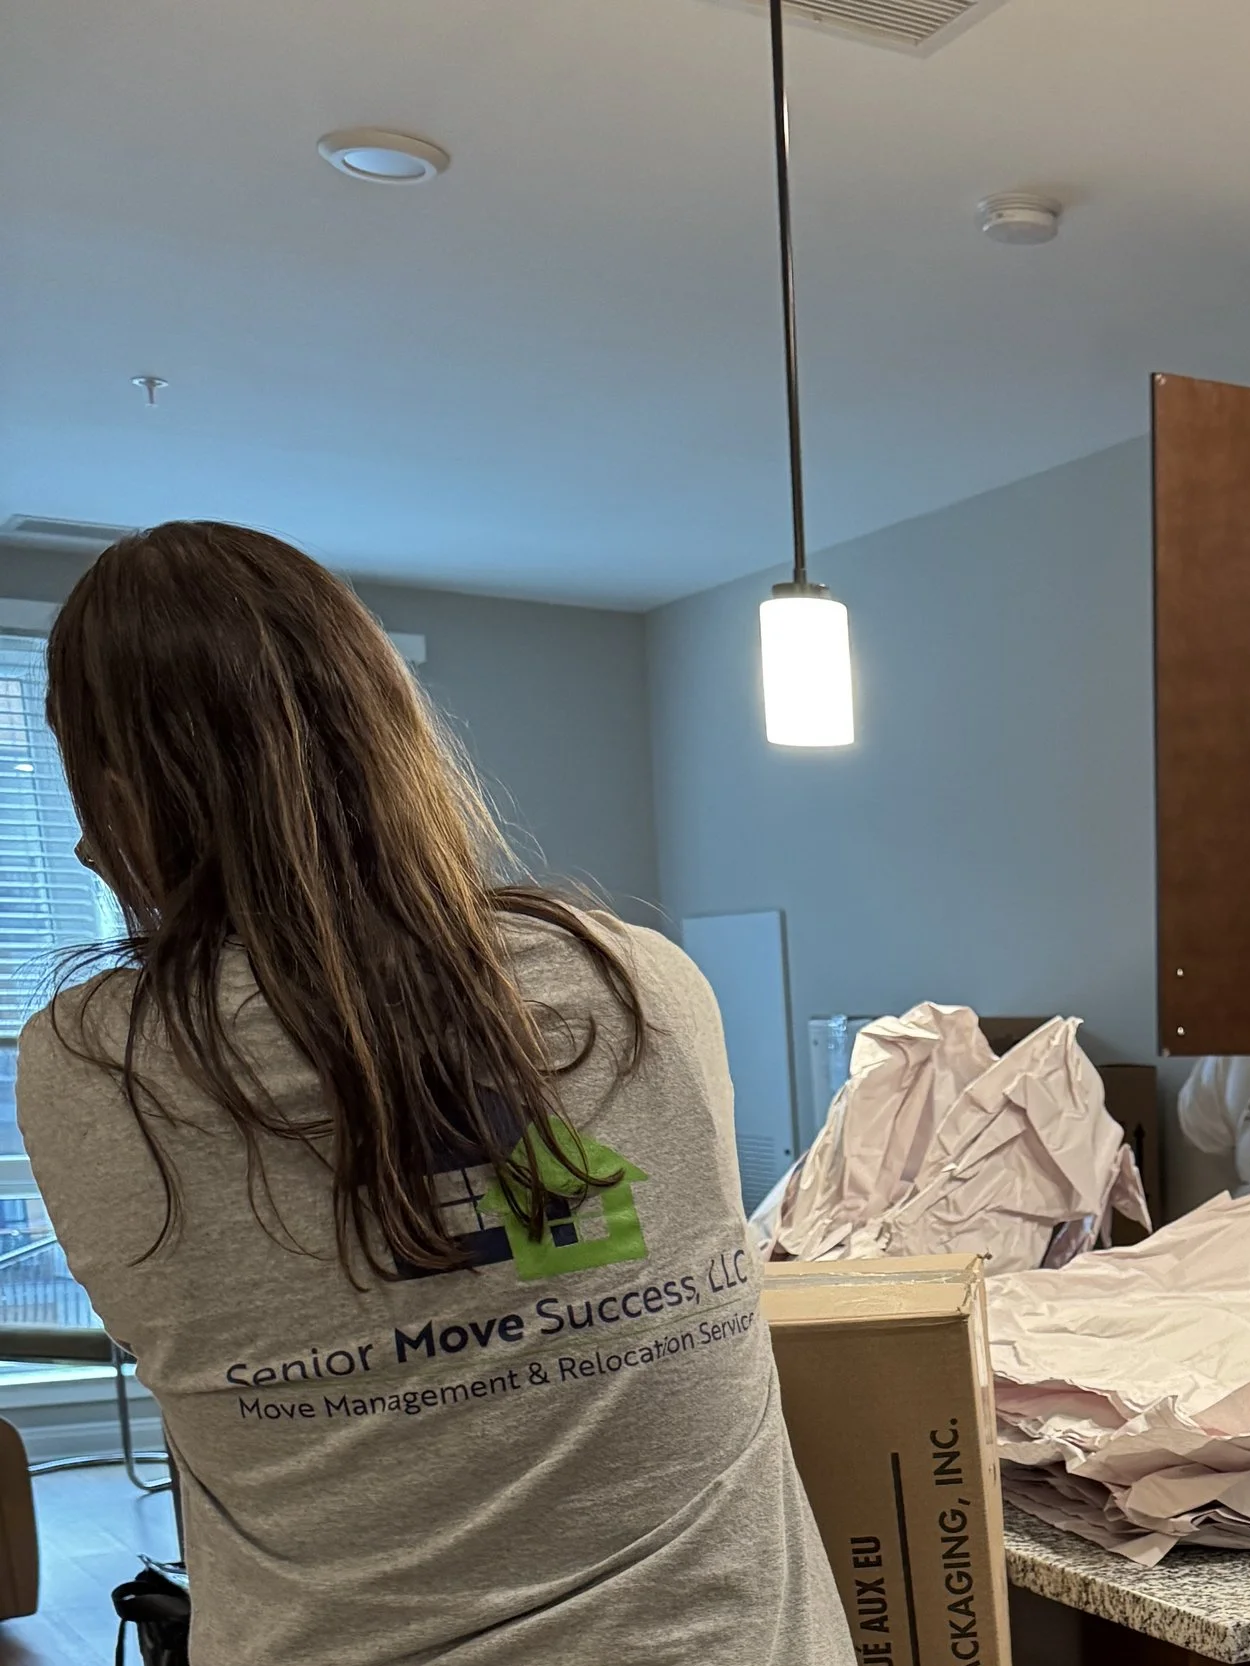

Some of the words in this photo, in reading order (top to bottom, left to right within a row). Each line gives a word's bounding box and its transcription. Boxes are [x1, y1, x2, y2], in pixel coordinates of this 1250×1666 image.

[226, 1346, 373, 1388] Senior
[394, 1320, 525, 1364] Move
[536, 1276, 700, 1335] Success,
[708, 1249, 748, 1293] LLC
[239, 1396, 315, 1420] Move
[323, 1370, 521, 1418] Management
[528, 1362, 550, 1386] &
[558, 1332, 695, 1382] Relocation
[930, 1418, 963, 1486] INC.
[850, 1536, 883, 1569] EU
[854, 1577, 890, 1633] AUX
